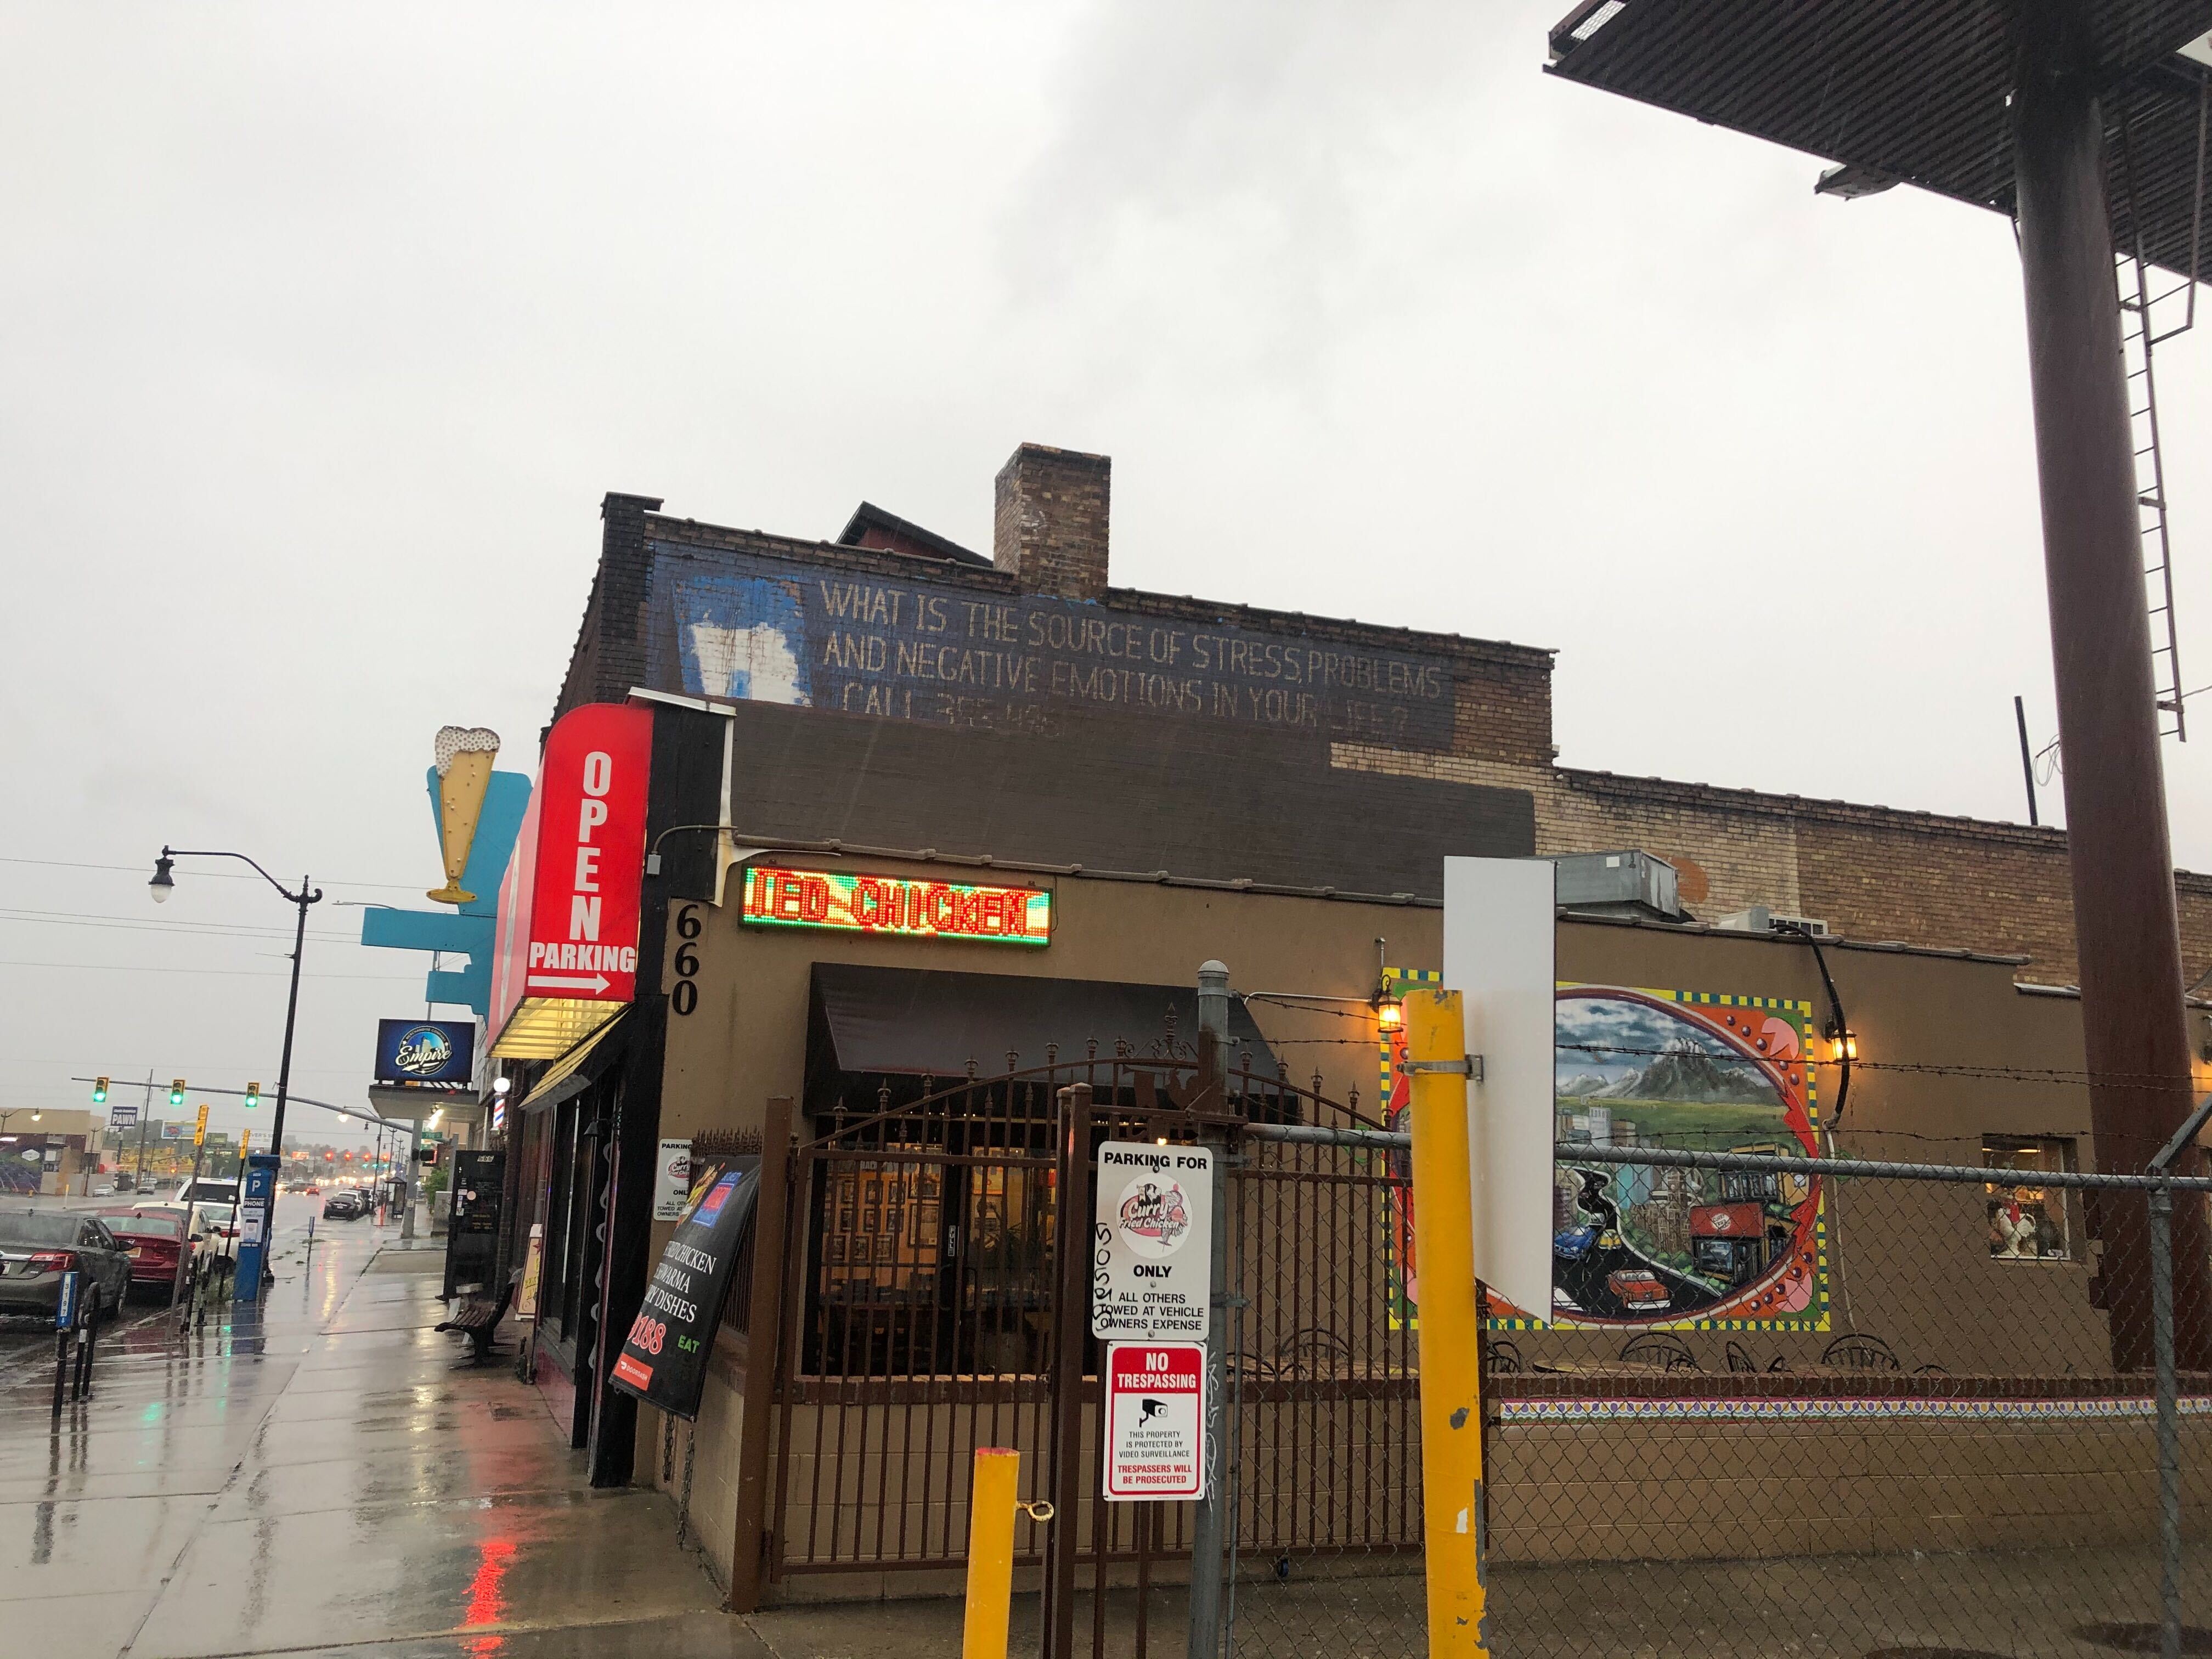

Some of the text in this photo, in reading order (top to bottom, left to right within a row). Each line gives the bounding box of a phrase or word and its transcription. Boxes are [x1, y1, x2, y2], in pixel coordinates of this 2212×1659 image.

[820, 580, 907, 625] WHAT
[916, 594, 947, 632] IS
[961, 601, 1018, 642] THE
[1029, 611, 1143, 659] SOURCE
[1150, 628, 1186, 665] OF
[1308, 650, 1441, 699] PROBLEMS
[822, 630, 887, 672] AND
[896, 639, 1041, 693] NEGATIVE
[1052, 661, 1202, 711] EMOTIONS
[1212, 681, 1238, 717] IN
[1249, 685, 1317, 727] YOUR
[568, 751, 612, 941] OPEN
[851, 879, 1028, 936] CHICKEN
[529, 941, 636, 973] PARKING
[672, 904, 702, 1016] 660
[395, 1045, 453, 1065] Empire
[112, 1114, 136, 1125] PAWN
[1104, 1152, 1207, 1170] PARKING FOR
[251, 1180, 261, 1192] P
[1128, 1201, 1169, 1221] Curry
[1119, 1217, 1180, 1229] Fried Chicken
[675, 1244, 717, 1275] CHICKEN
[1133, 1264, 1172, 1278] ONLY
[654, 1289, 697, 1323] DISHES
[1119, 1292, 1186, 1304] ALL OTHERS
[1101, 1305, 1204, 1318] TOWED AT VEHICLE
[1100, 1318, 1202, 1330] OWNERS EXPENSE
[678, 1334, 701, 1353] EAT
[1146, 1352, 1169, 1372] NO
[1117, 1373, 1197, 1389] TRESPASSING
[1117, 1465, 1192, 1474] TRESPASSERS WILL
[1122, 1475, 1187, 1484] BE PROSECUTED
